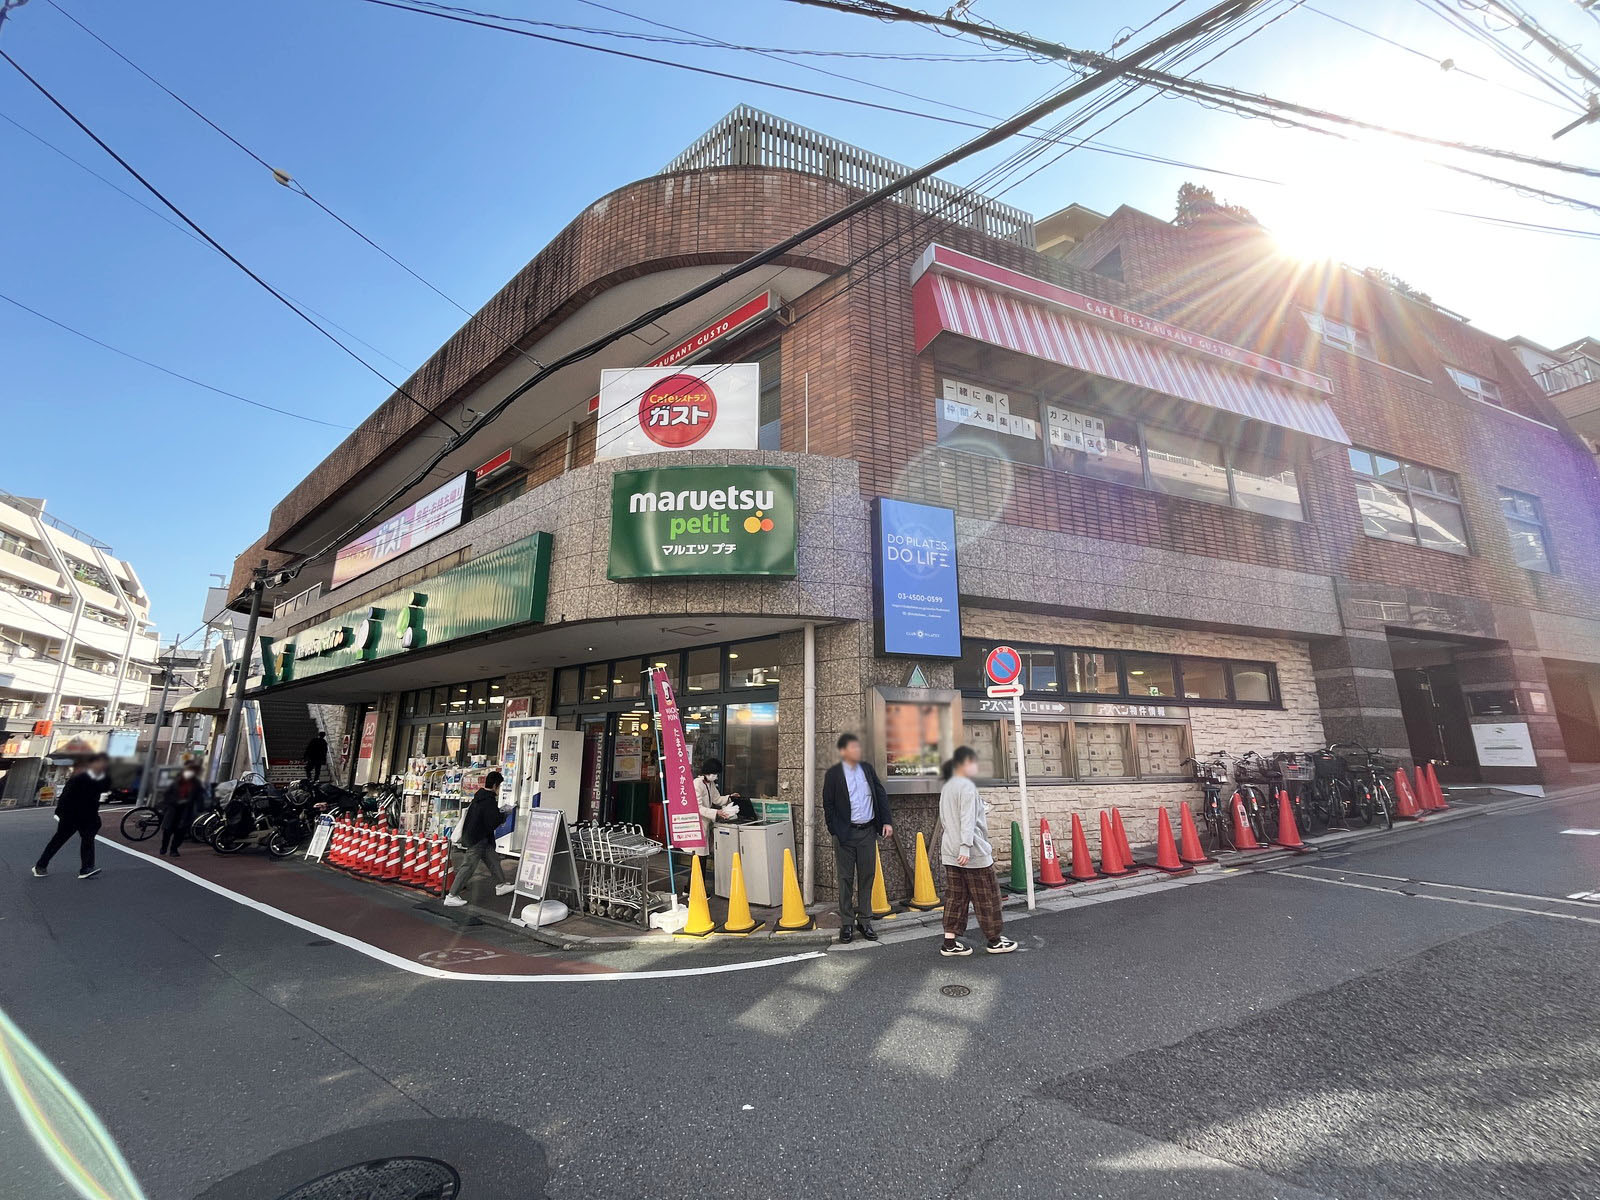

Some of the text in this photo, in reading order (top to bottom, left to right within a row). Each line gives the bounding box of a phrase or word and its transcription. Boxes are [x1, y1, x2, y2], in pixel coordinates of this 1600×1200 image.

[654, 322, 729, 367] AURANT GUSTO
[1122, 311, 1194, 346] RESTAURANT
[1199, 340, 1232, 357] GUSTO
[945, 385, 1006, 408] 一緒に働く
[649, 405, 710, 427] ガスト
[629, 485, 774, 513] maruetsu
[670, 511, 730, 540] petit
[661, 542, 737, 556] マルエツ プチ
[887, 533, 904, 545] DO
[887, 546, 913, 563] DO
[897, 592, 943, 604] 03-4500-0599
[548, 740, 560, 790] 証明写真
